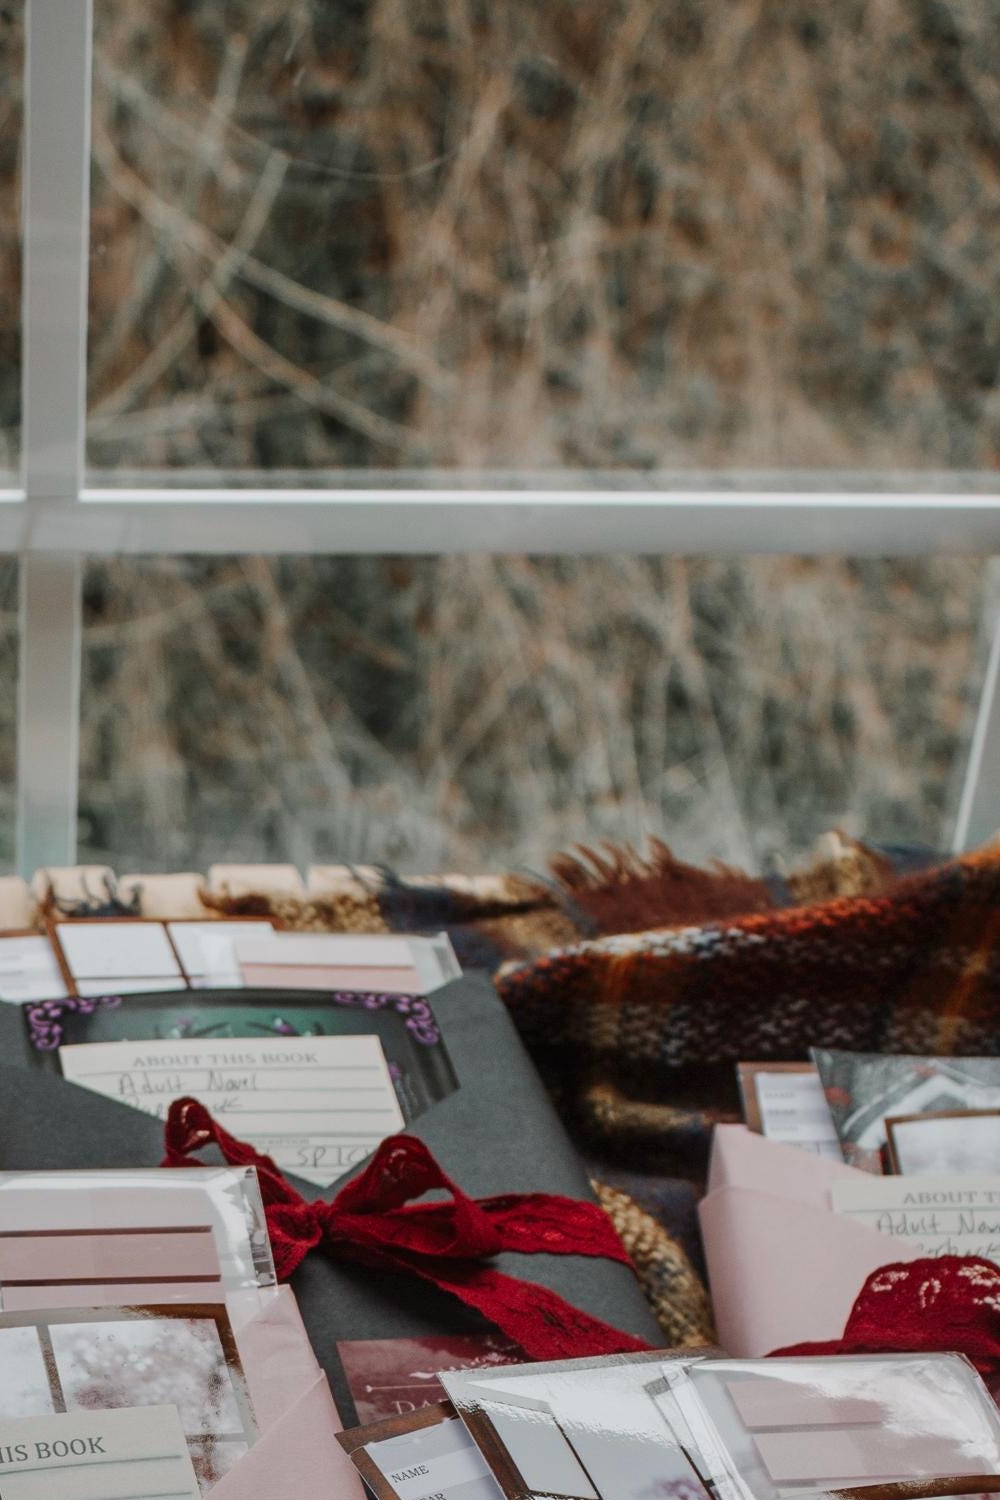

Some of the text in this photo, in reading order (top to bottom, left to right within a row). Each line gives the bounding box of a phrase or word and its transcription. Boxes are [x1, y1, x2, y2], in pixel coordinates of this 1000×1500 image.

[903, 1191, 978, 1204] ABOUT
[877, 1210, 941, 1236] Adult
[36, 1436, 107, 1460] BOOK
[391, 1464, 430, 1484] NAME
